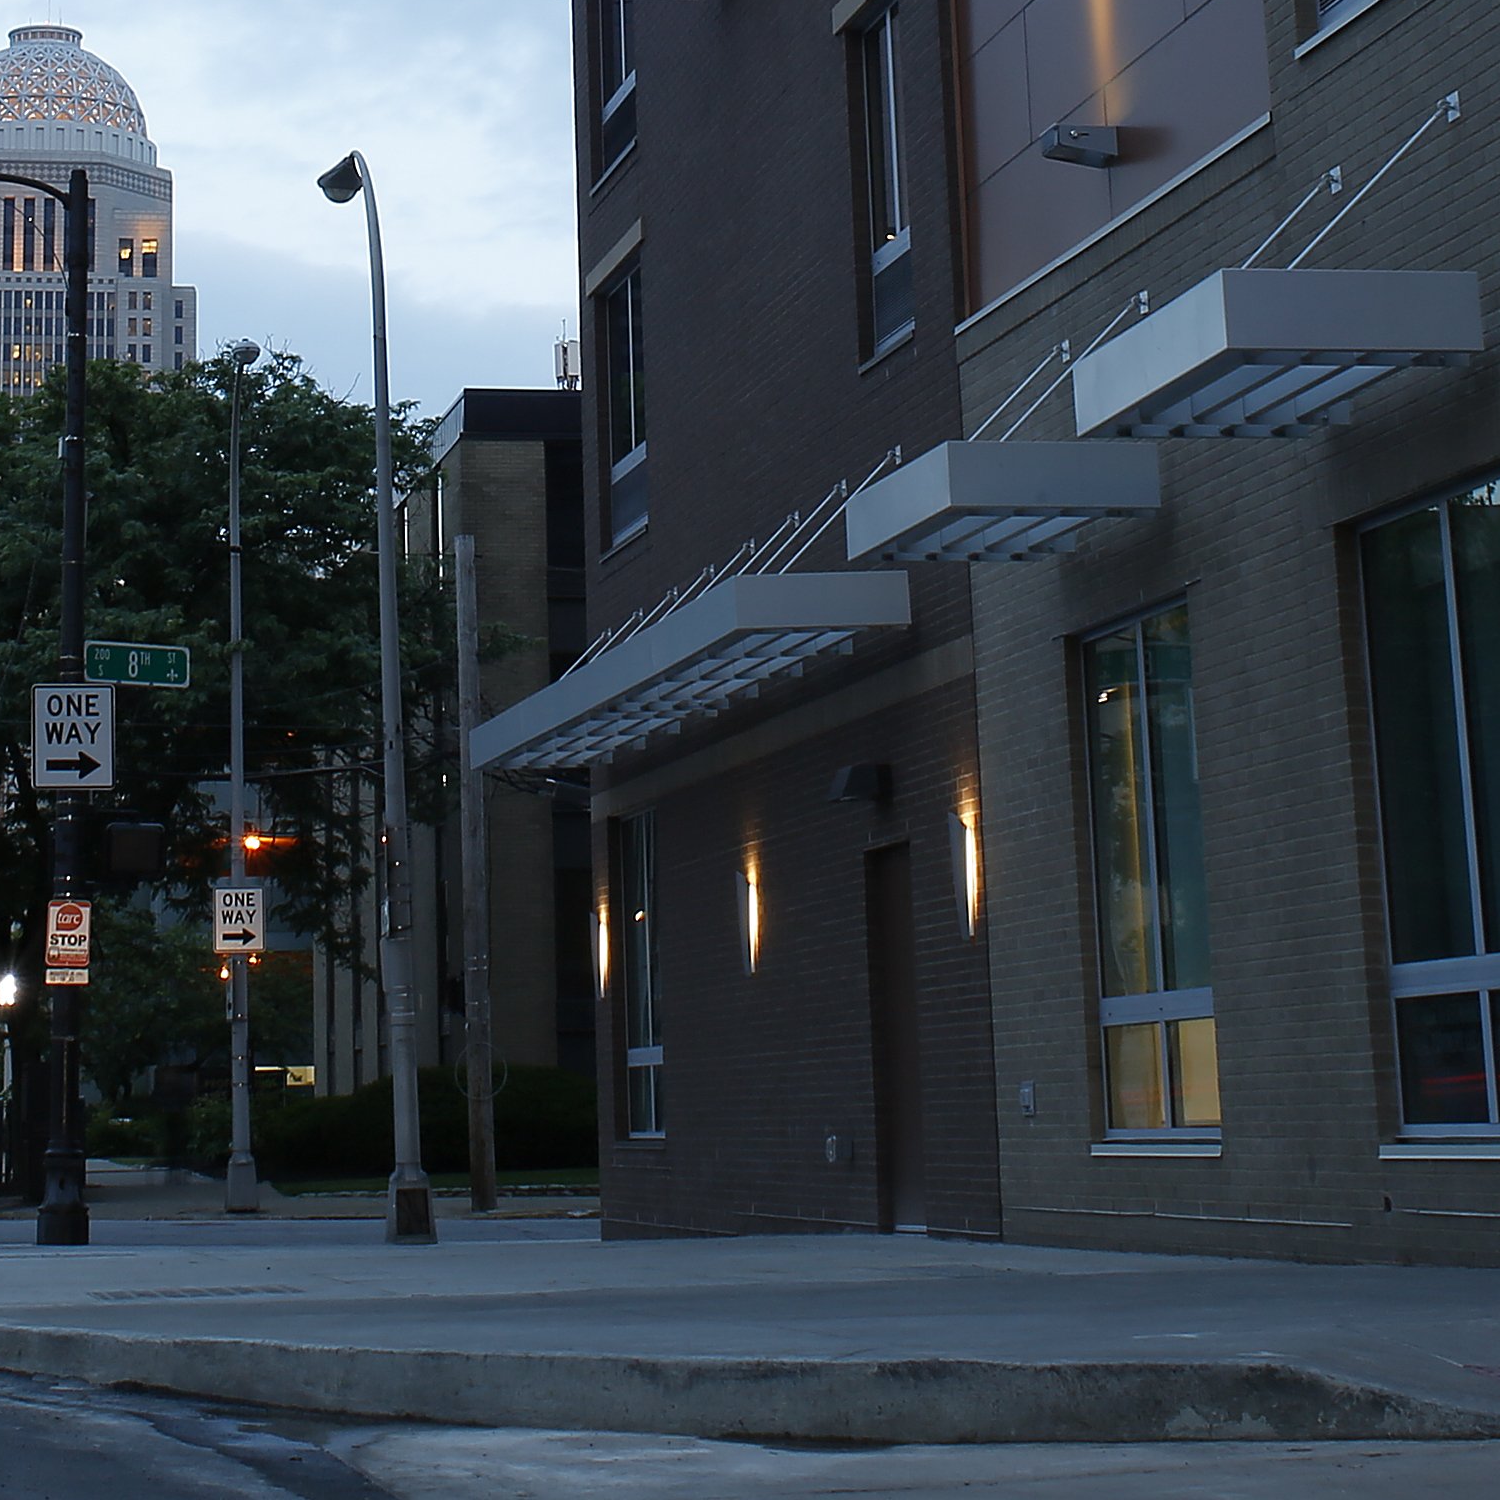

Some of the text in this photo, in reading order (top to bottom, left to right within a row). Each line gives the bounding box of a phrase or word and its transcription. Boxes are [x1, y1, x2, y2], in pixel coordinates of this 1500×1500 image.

[94, 648, 177, 678] 200 8TH ST
[97, 663, 104, 677] S
[46, 694, 100, 717] ONE
[44, 722, 102, 745] WAY
[222, 892, 256, 907] ONE
[57, 912, 81, 925] tarc
[221, 909, 257, 925] WAY
[49, 933, 88, 947] STOP
